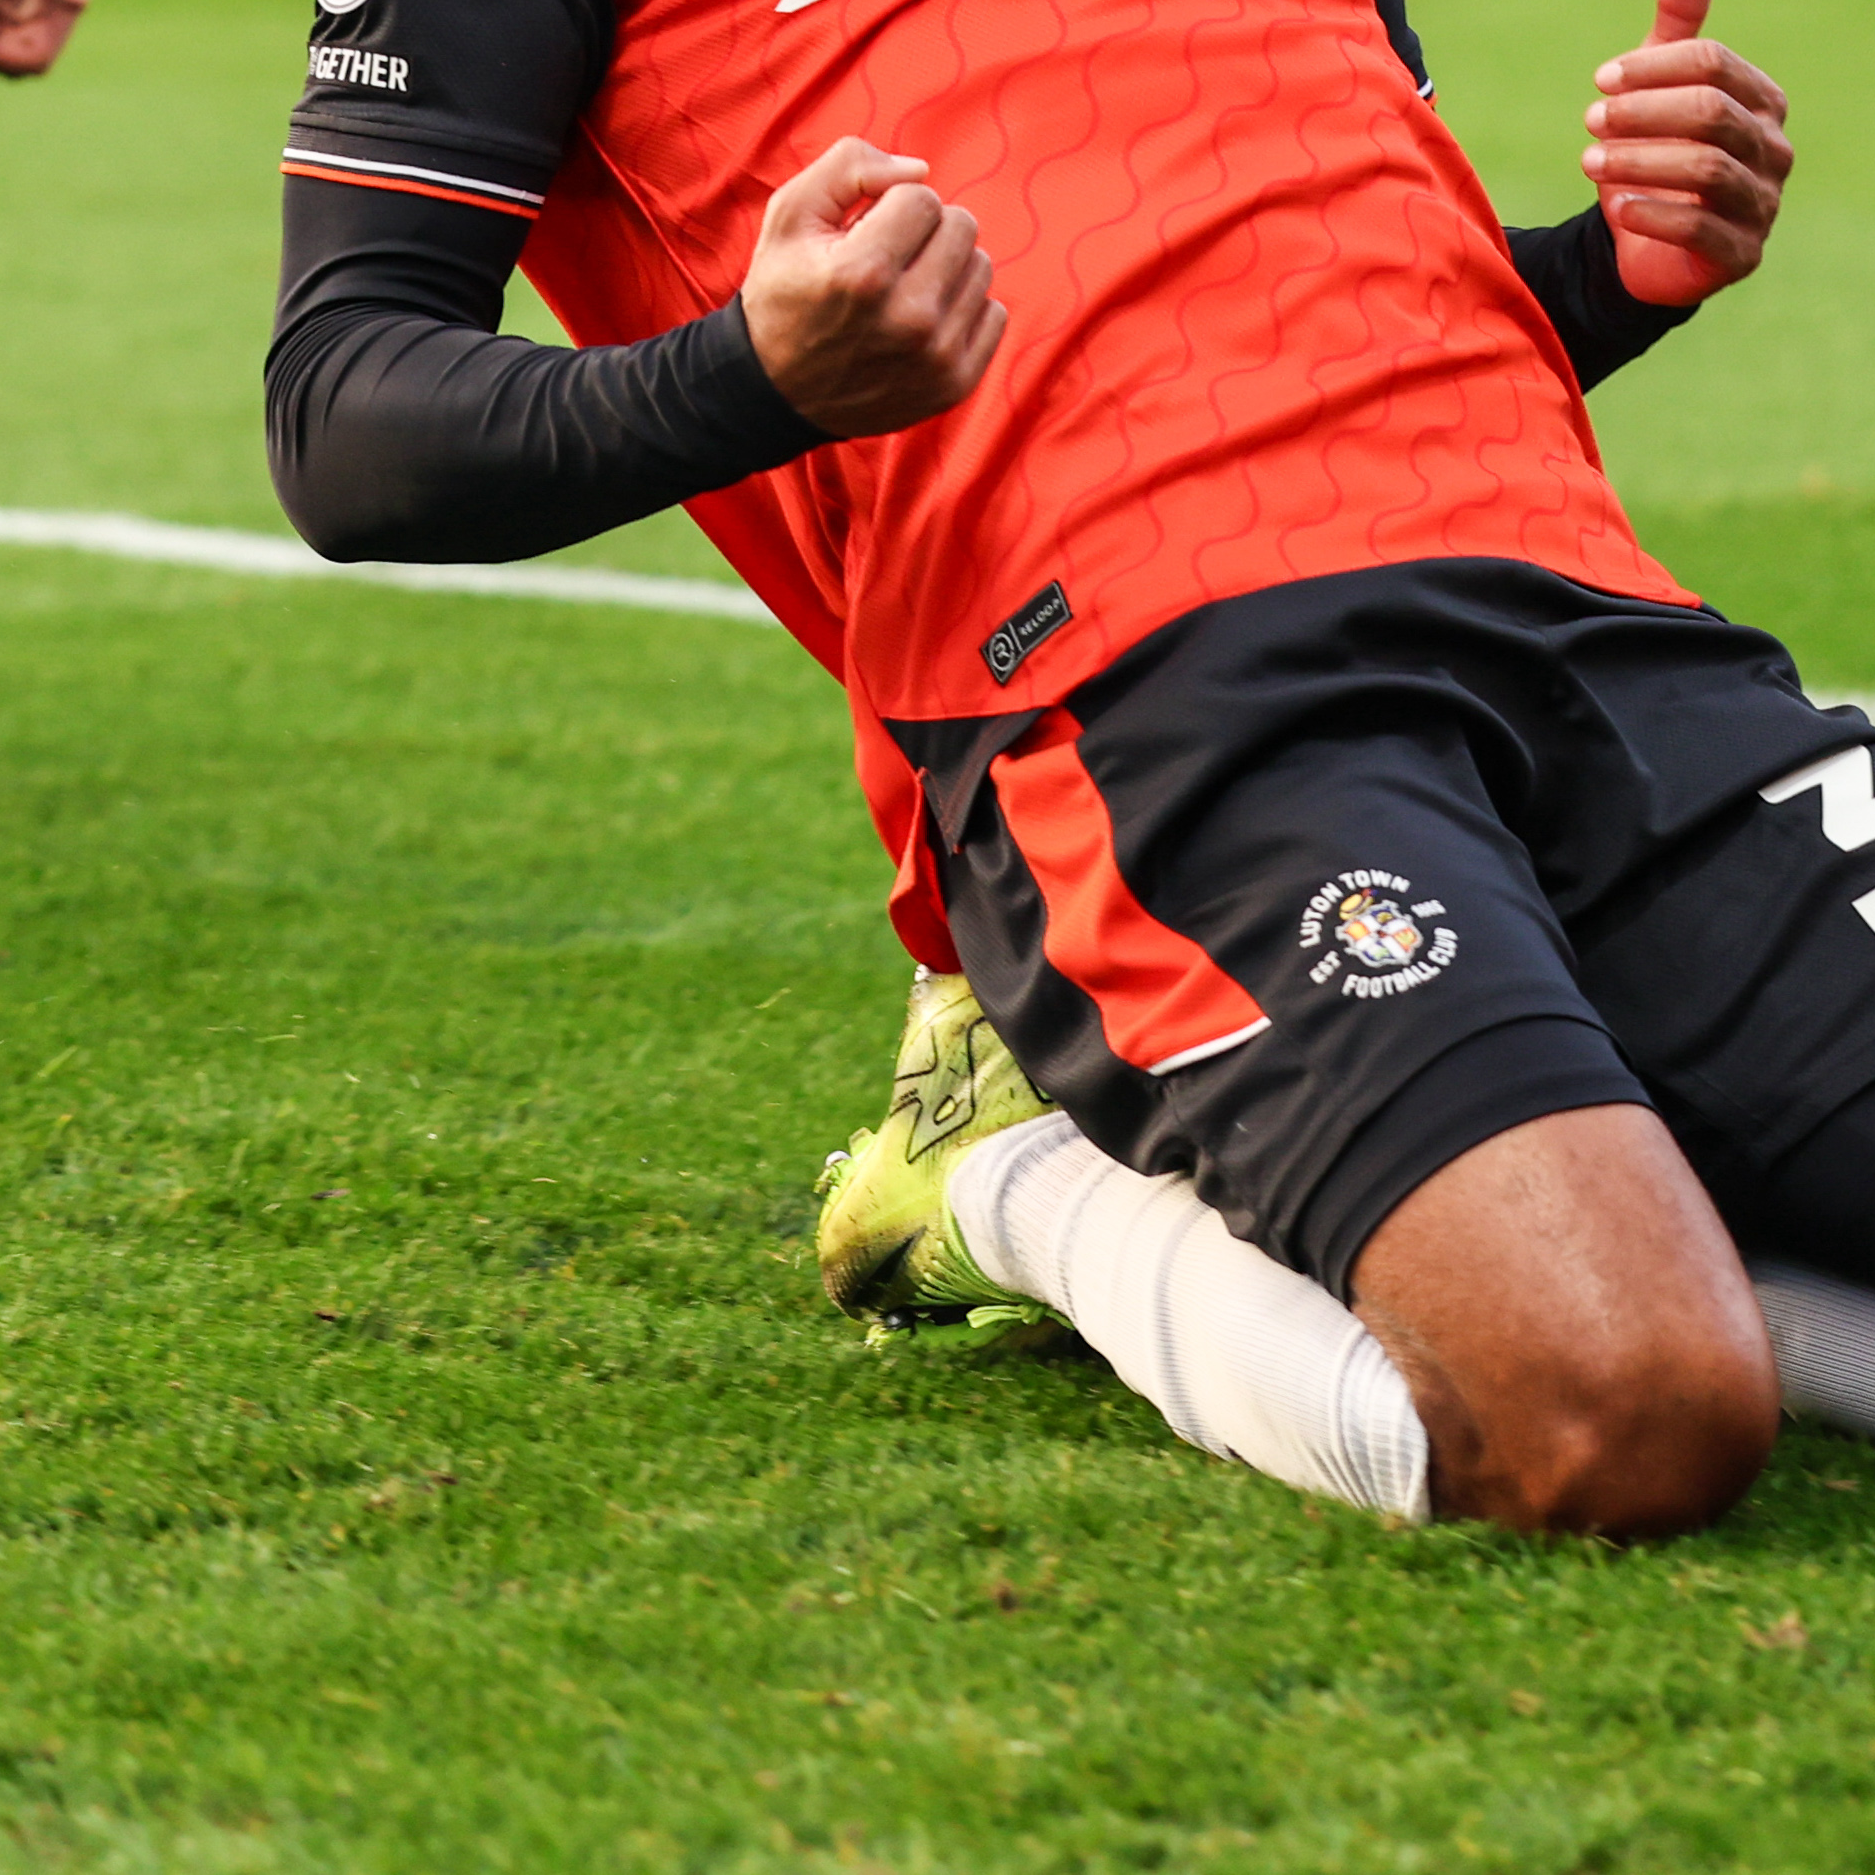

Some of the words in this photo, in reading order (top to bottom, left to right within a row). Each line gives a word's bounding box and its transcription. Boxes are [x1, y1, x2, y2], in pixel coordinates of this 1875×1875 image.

[309, 46, 409, 92] GETHER
[1299, 882, 1344, 948] LUTON
[1337, 869, 1411, 893] TOWN
[1309, 950, 1342, 984] EST
[1341, 960, 1442, 999] FOOTBALL
